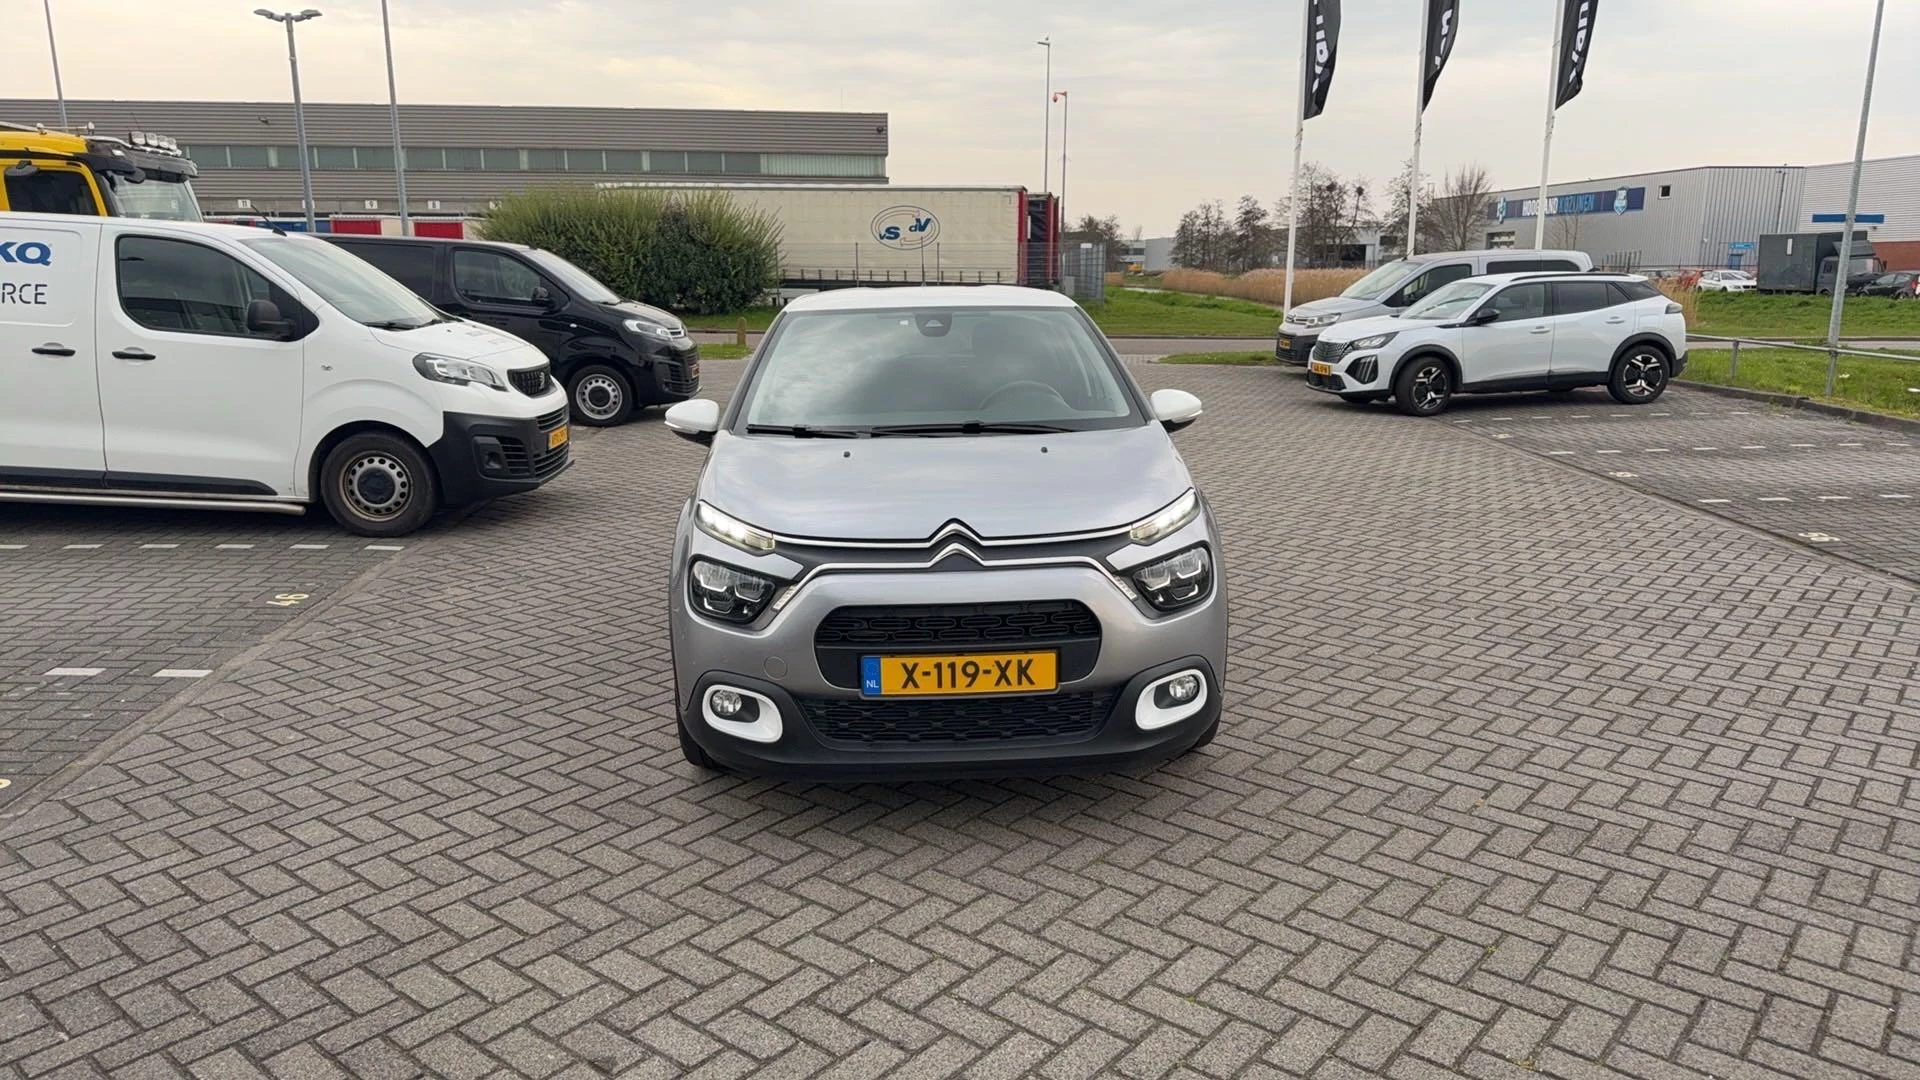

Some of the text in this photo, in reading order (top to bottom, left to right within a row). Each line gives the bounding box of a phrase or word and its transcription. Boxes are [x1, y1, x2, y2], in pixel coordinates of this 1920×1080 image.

[2, 283, 48, 304] RCE
[866, 659, 1036, 688] NL X-119-XK
